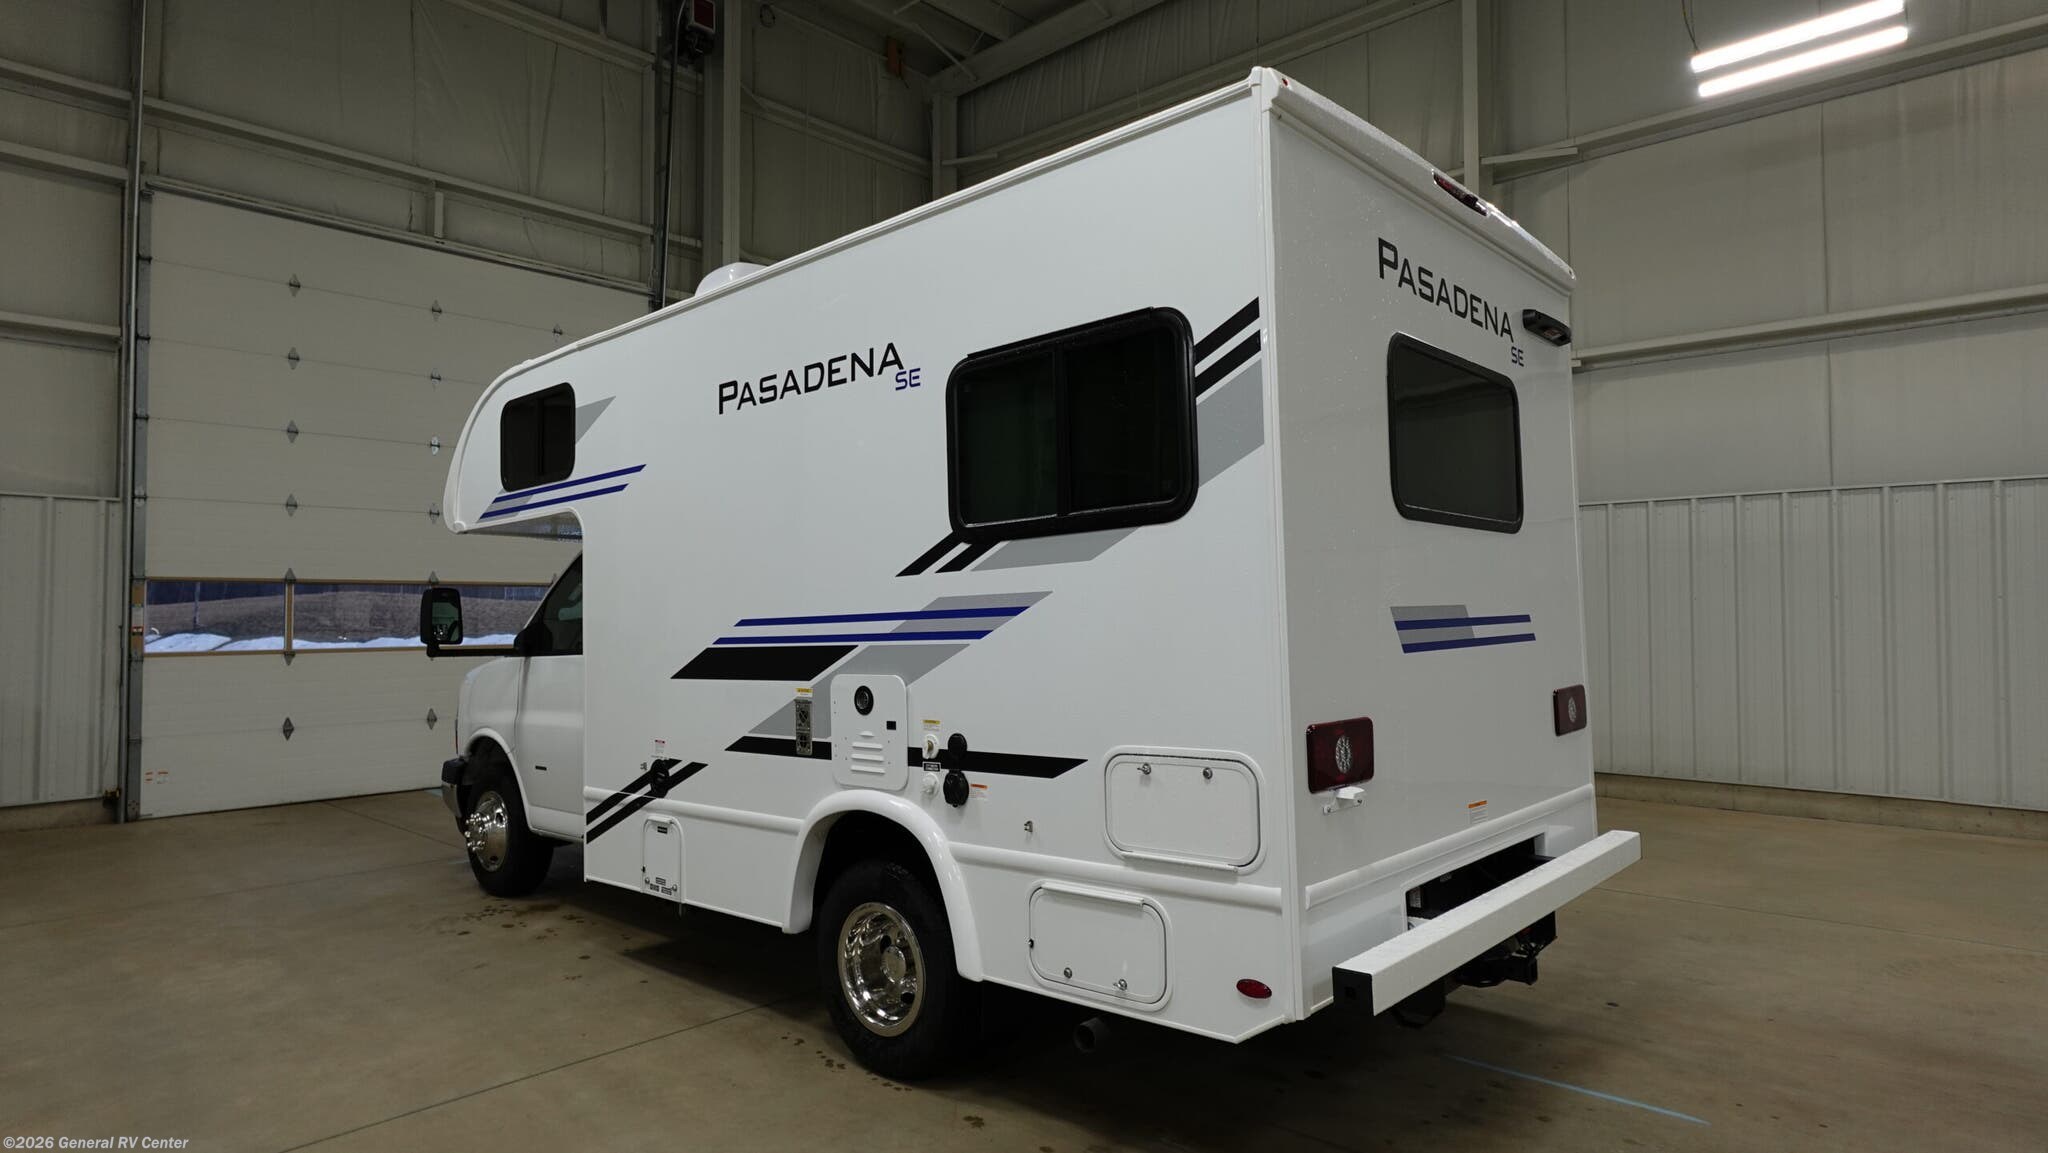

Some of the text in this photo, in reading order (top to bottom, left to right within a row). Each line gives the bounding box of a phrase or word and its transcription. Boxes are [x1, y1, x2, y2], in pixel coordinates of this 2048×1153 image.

[1378, 237, 1514, 344] PASADENA
[719, 342, 904, 415] PASADENA
[894, 367, 921, 392] SE
[1510, 345, 1525, 368] SE
